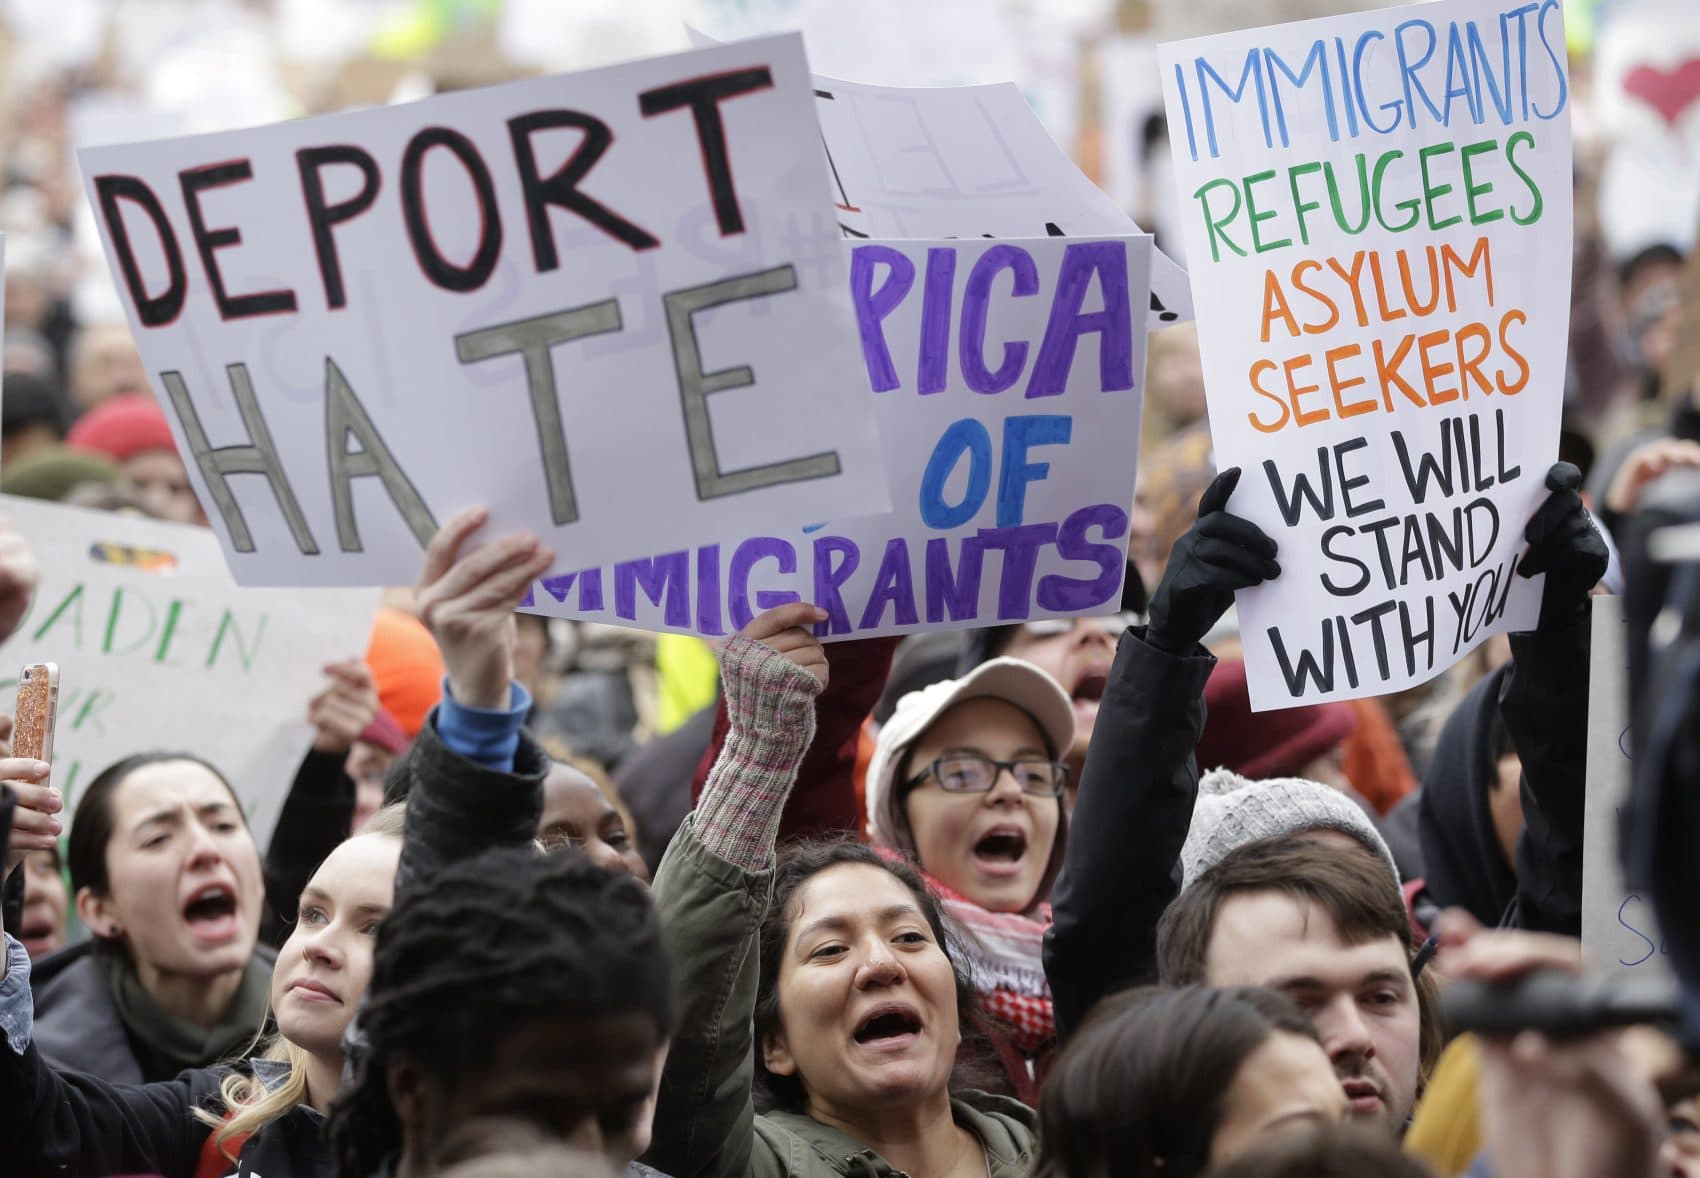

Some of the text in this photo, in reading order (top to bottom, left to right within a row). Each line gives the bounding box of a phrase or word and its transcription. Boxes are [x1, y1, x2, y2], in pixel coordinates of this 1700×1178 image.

[1174, 0, 1568, 161] IMMIGRANTS
[93, 66, 774, 327] DEPORT
[1193, 131, 1544, 262] REFUGEES
[1260, 237, 1494, 342] ASYLUM
[158, 262, 843, 557] HATE
[1248, 309, 1530, 433] SEEKERS
[918, 414, 1073, 531] OF
[1262, 408, 1521, 527] WE WILL
[1319, 497, 1500, 597] STAND
[0, 582, 269, 672] ADEN
[1267, 552, 1519, 698] WITH YOU
